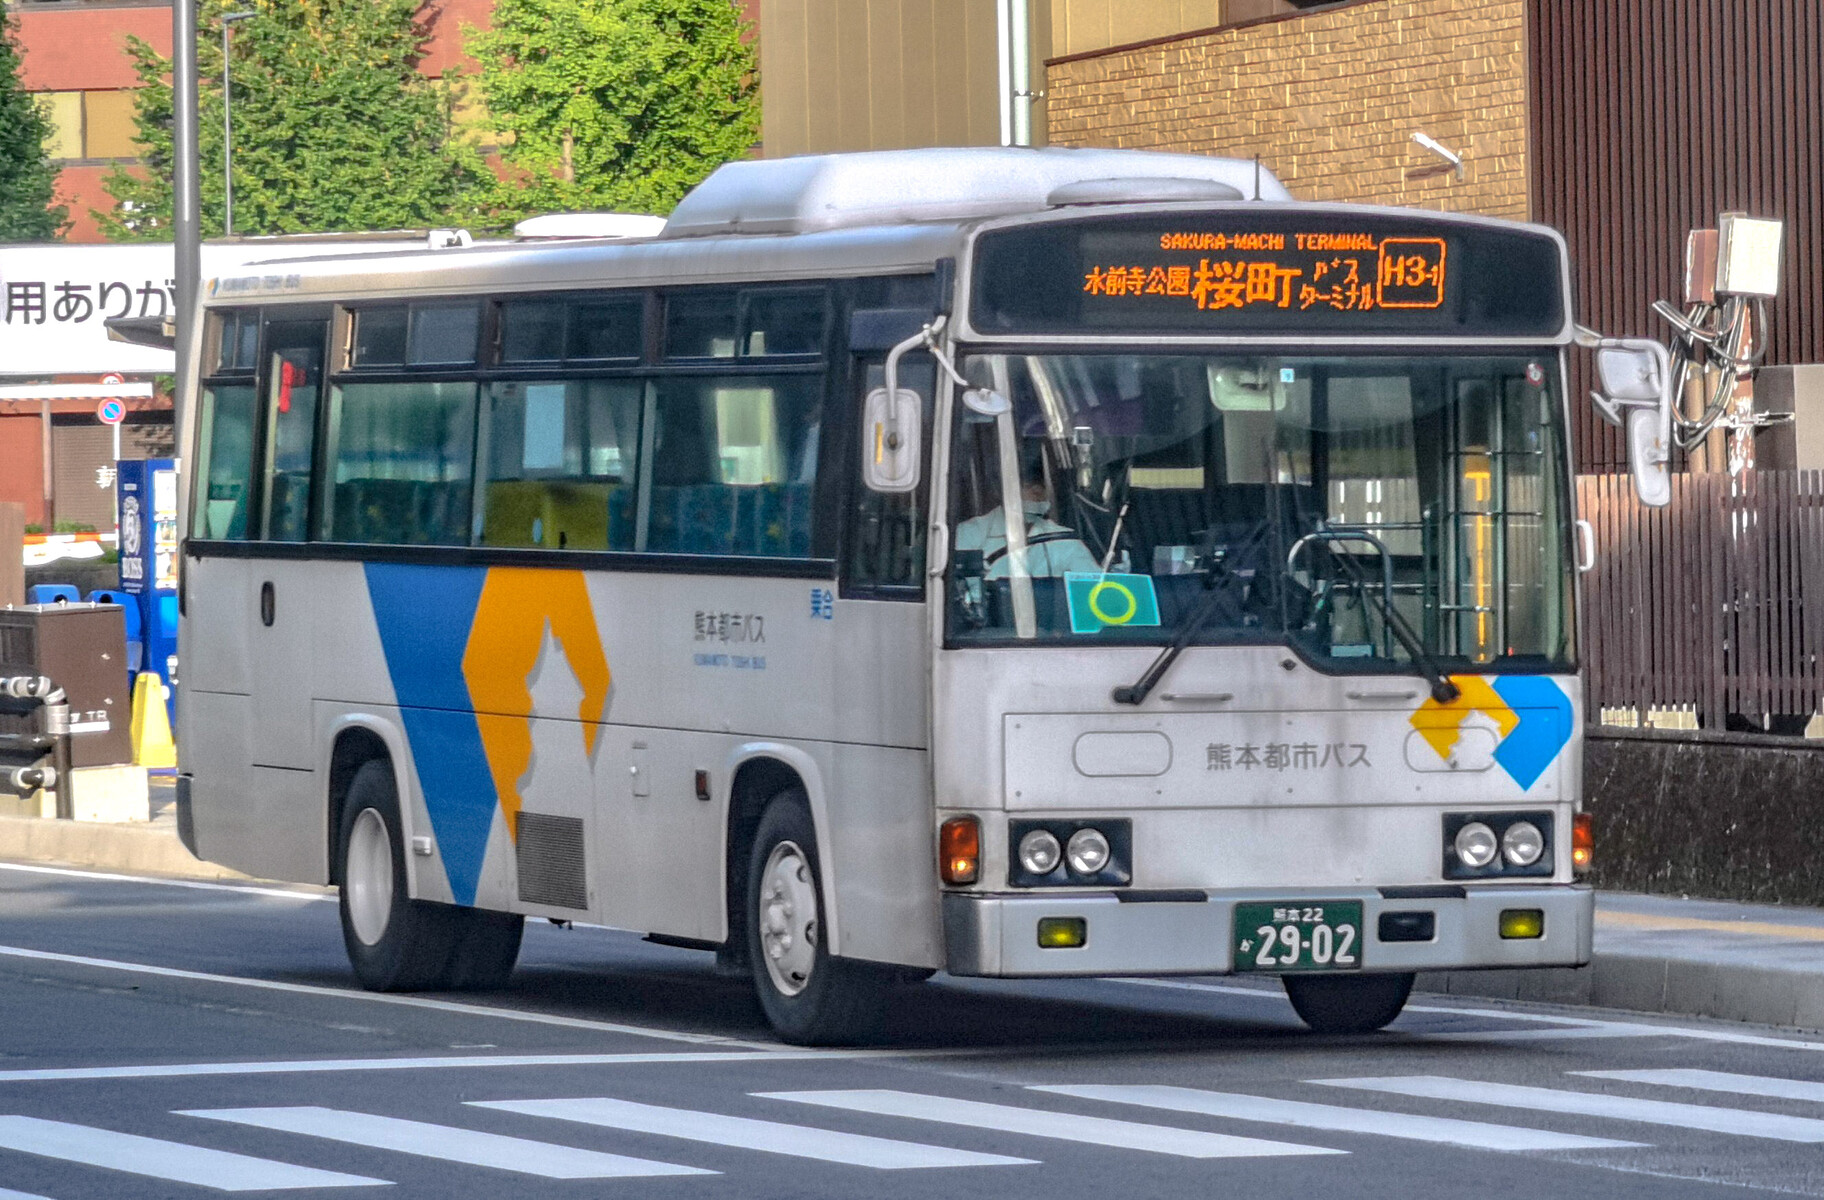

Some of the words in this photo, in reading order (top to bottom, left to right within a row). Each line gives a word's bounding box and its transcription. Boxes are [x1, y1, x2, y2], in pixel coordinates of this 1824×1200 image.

[1160, 233, 1285, 250] SAKURA-MACHI
[1294, 233, 1378, 250] TERMINAL
[1083, 265, 1191, 296] 水前寺公園
[1191, 259, 1303, 309] 桜町
[1383, 255, 1439, 287] H3-1
[5, 279, 176, 325] 用ありが
[1205, 742, 1372, 772] 熊本都市バス
[1255, 923, 1356, 965] 29-02
